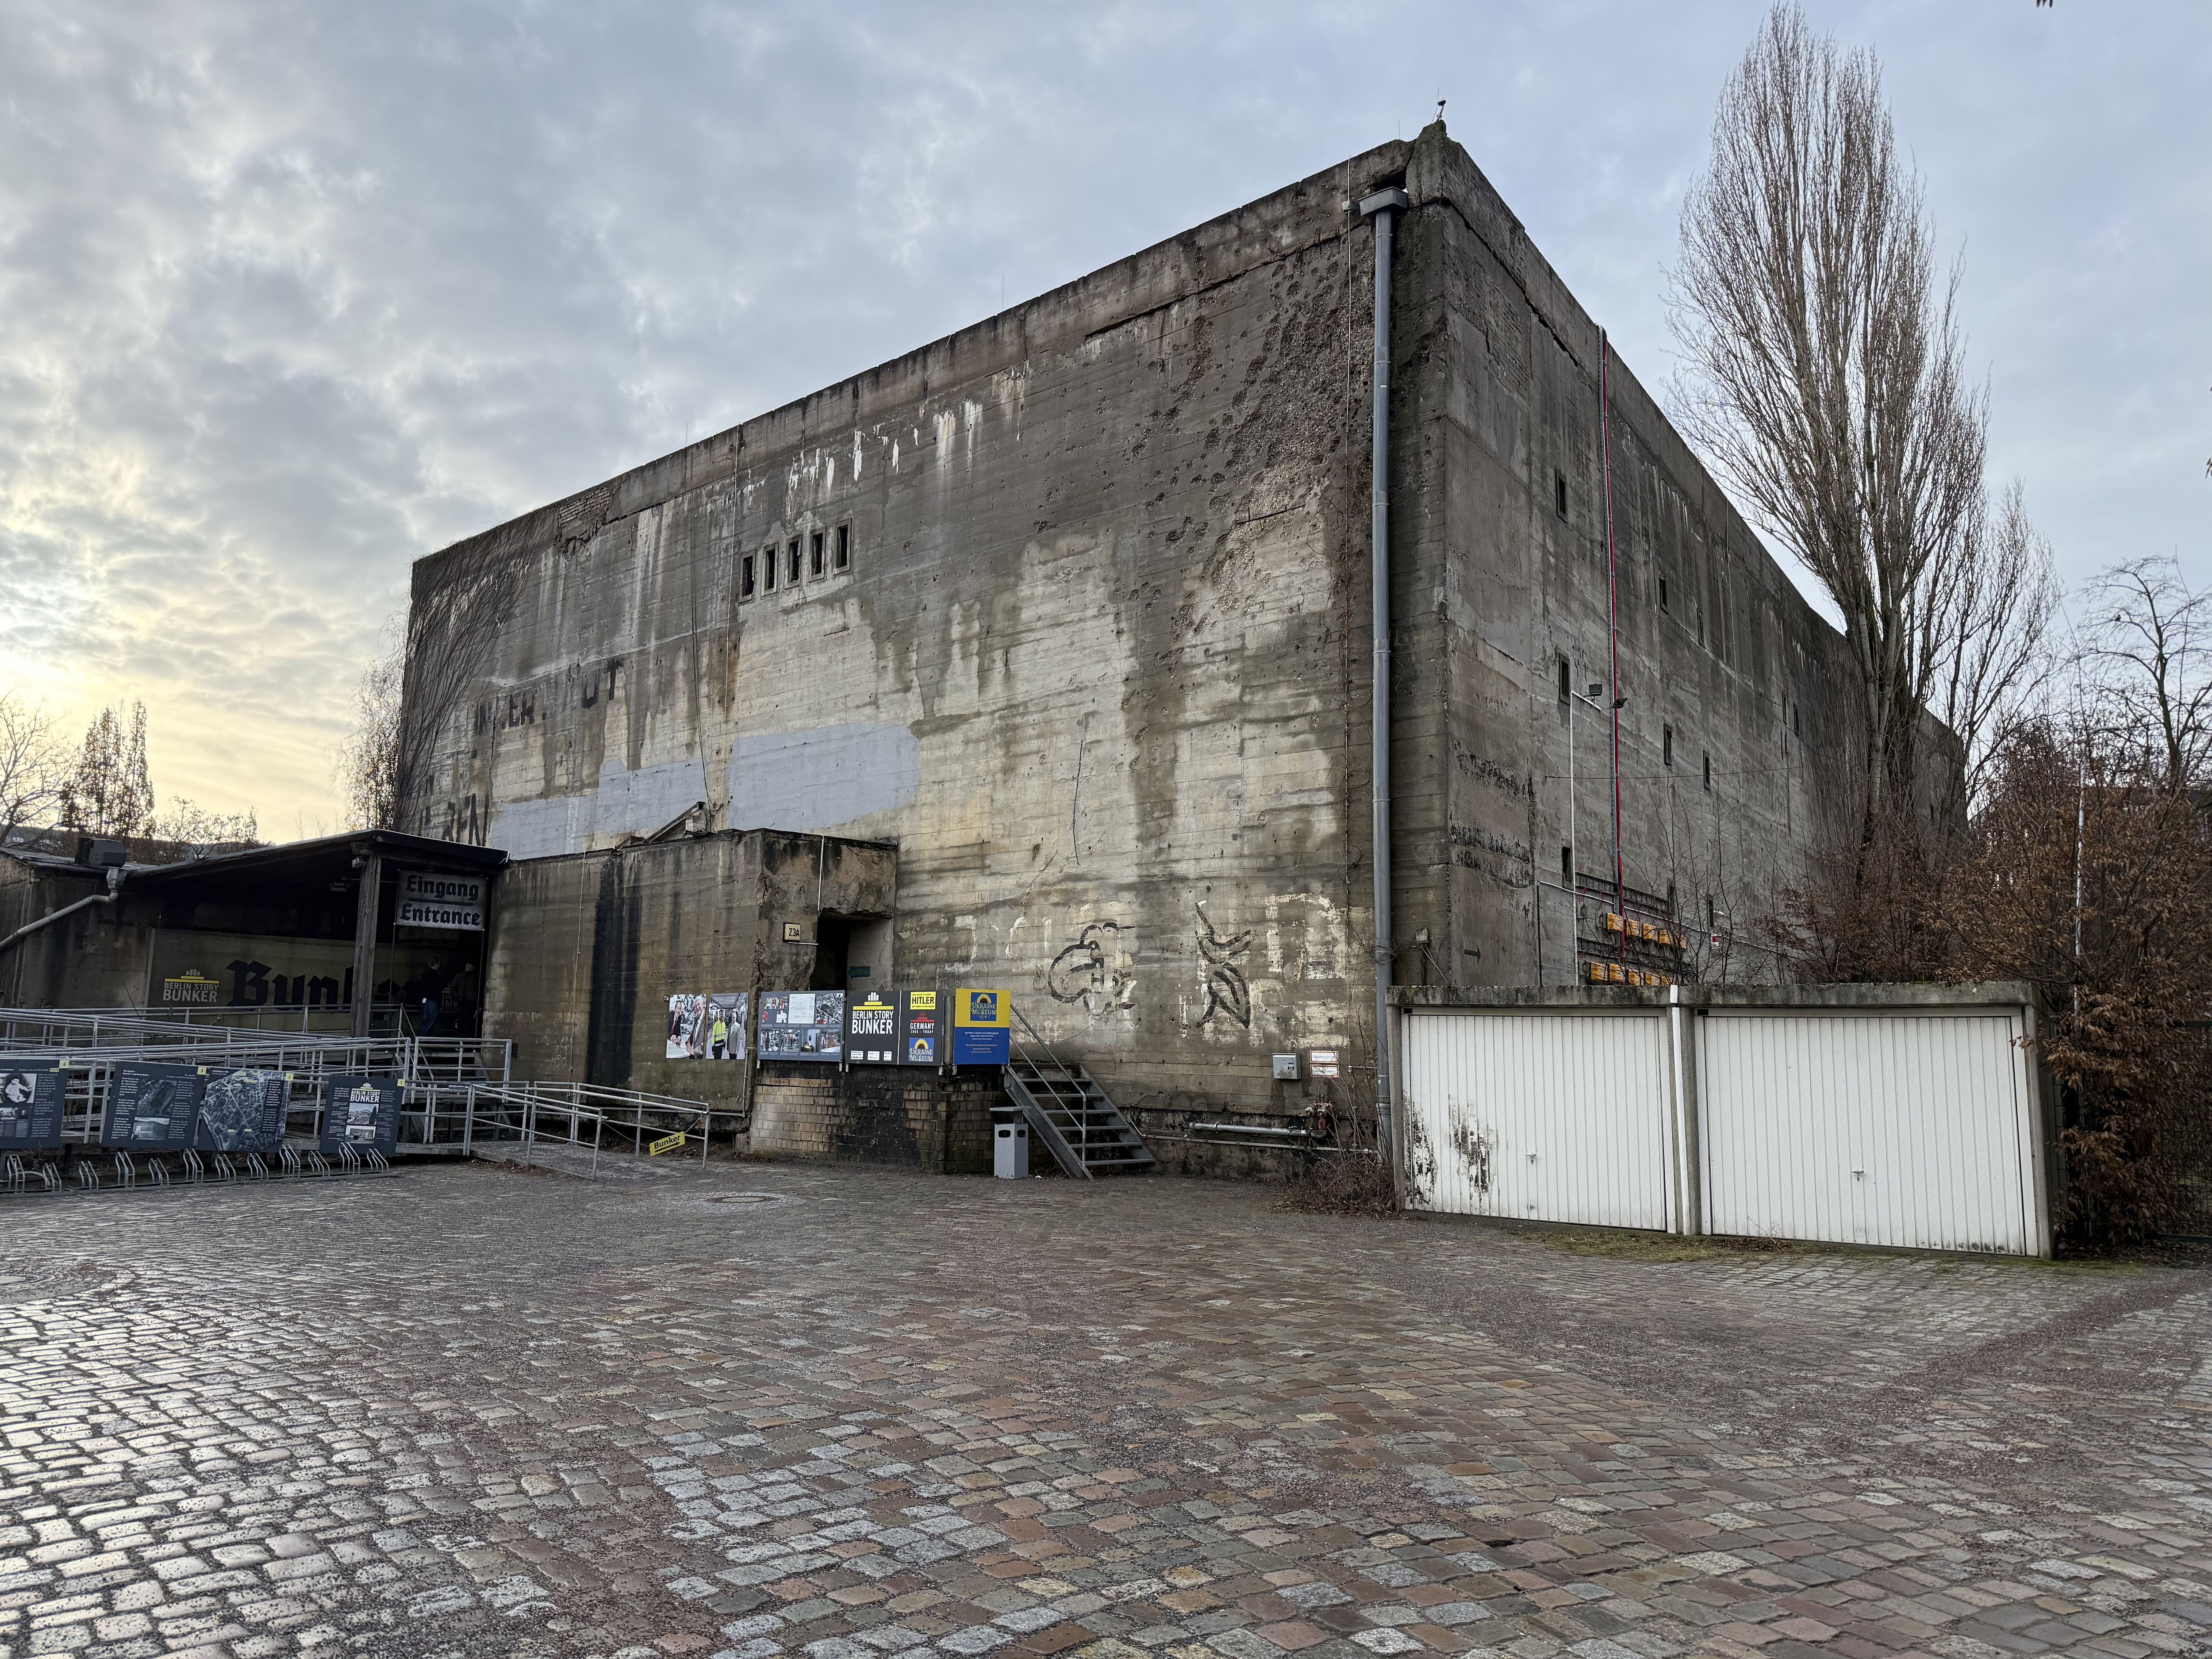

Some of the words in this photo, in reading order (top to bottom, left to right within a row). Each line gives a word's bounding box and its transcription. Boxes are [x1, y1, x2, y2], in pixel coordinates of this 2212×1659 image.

[405, 874, 479, 901] Eingang
[400, 903, 481, 926] Entrance
[789, 928, 799, 937] 23A
[163, 989, 218, 1003] BUNKER
[852, 1010, 873, 1019] BERLIN
[874, 1010, 894, 1019] STORY
[852, 1019, 893, 1034] BUNKER
[654, 1135, 680, 1149] Bunker
